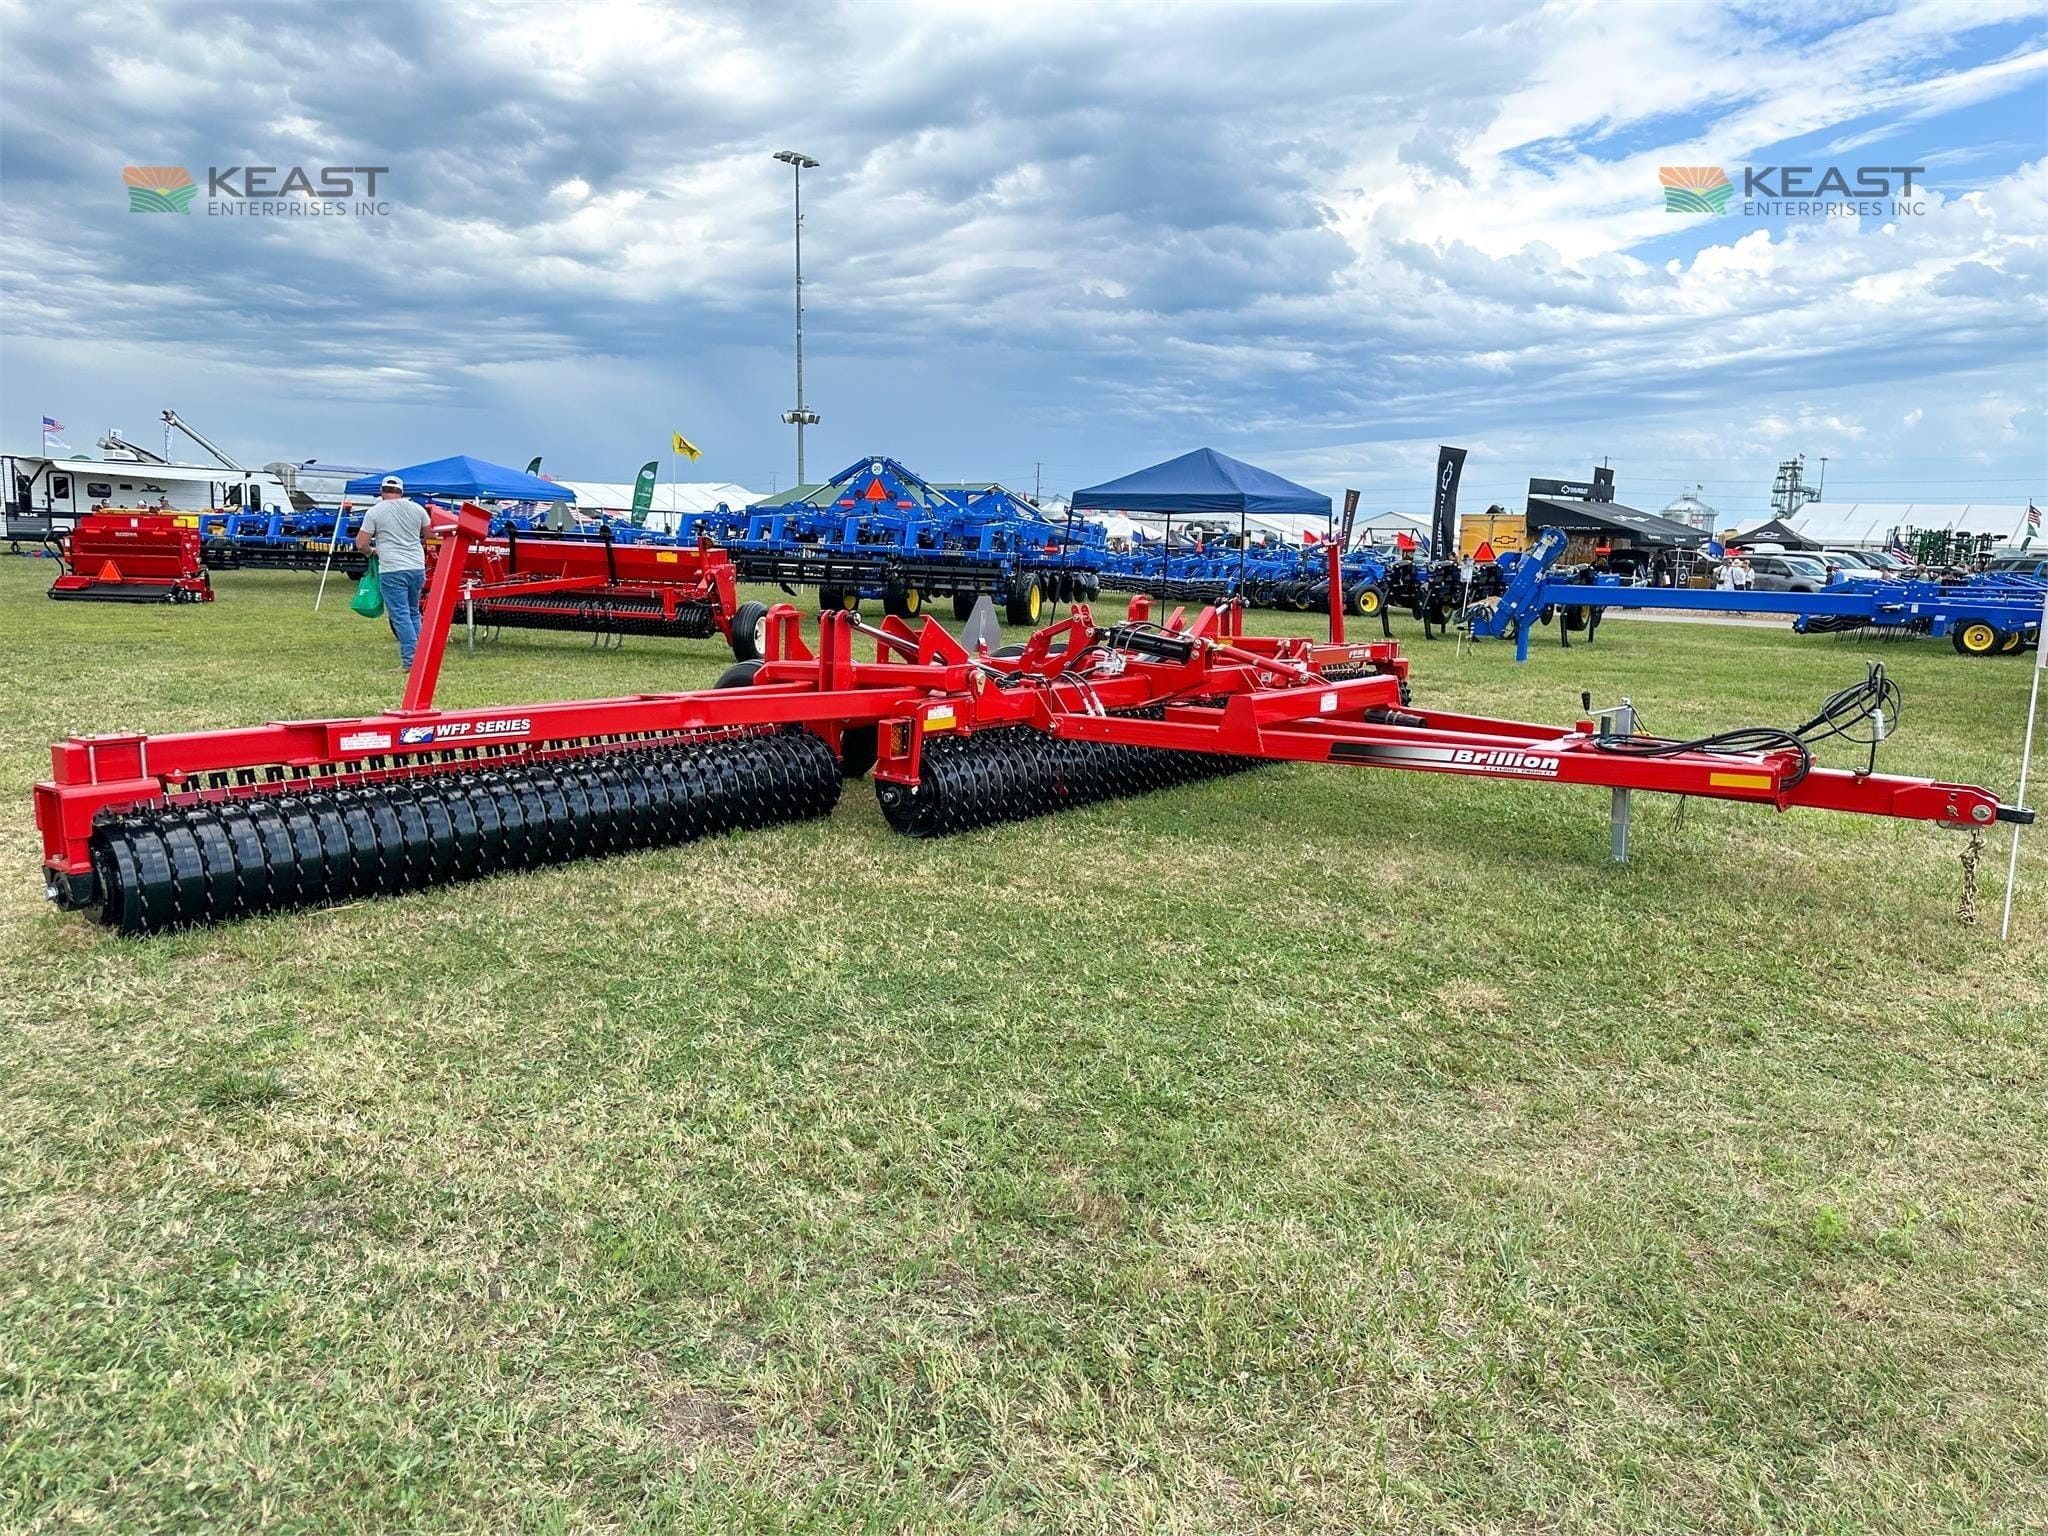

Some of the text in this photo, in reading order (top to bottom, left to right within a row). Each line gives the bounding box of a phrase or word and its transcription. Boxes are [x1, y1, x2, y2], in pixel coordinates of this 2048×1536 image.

[436, 718, 531, 737] WFP SERIES
[1453, 749, 1560, 770] Brillion
